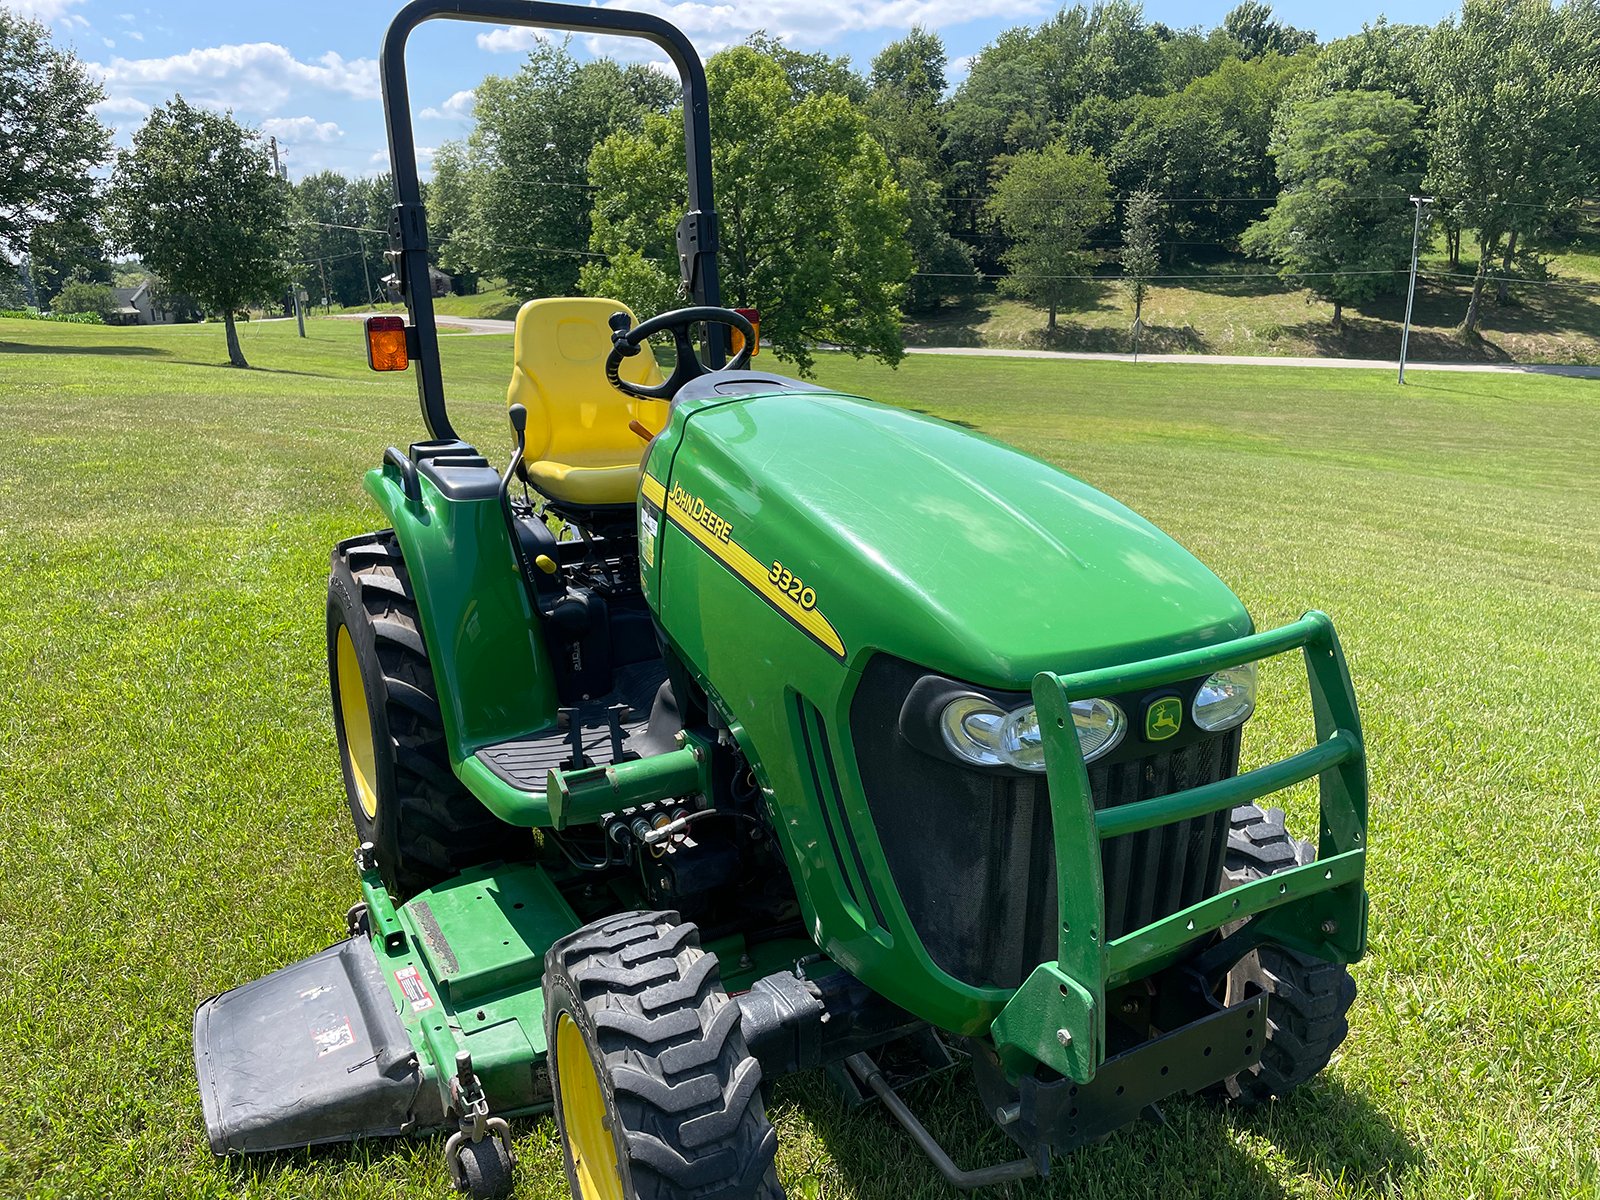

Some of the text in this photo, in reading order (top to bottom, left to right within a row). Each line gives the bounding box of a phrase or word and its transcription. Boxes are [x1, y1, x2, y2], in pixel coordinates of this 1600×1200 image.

[668, 481, 697, 515] JOHN
[692, 497, 734, 544] DEERE
[768, 559, 817, 611] 3320
